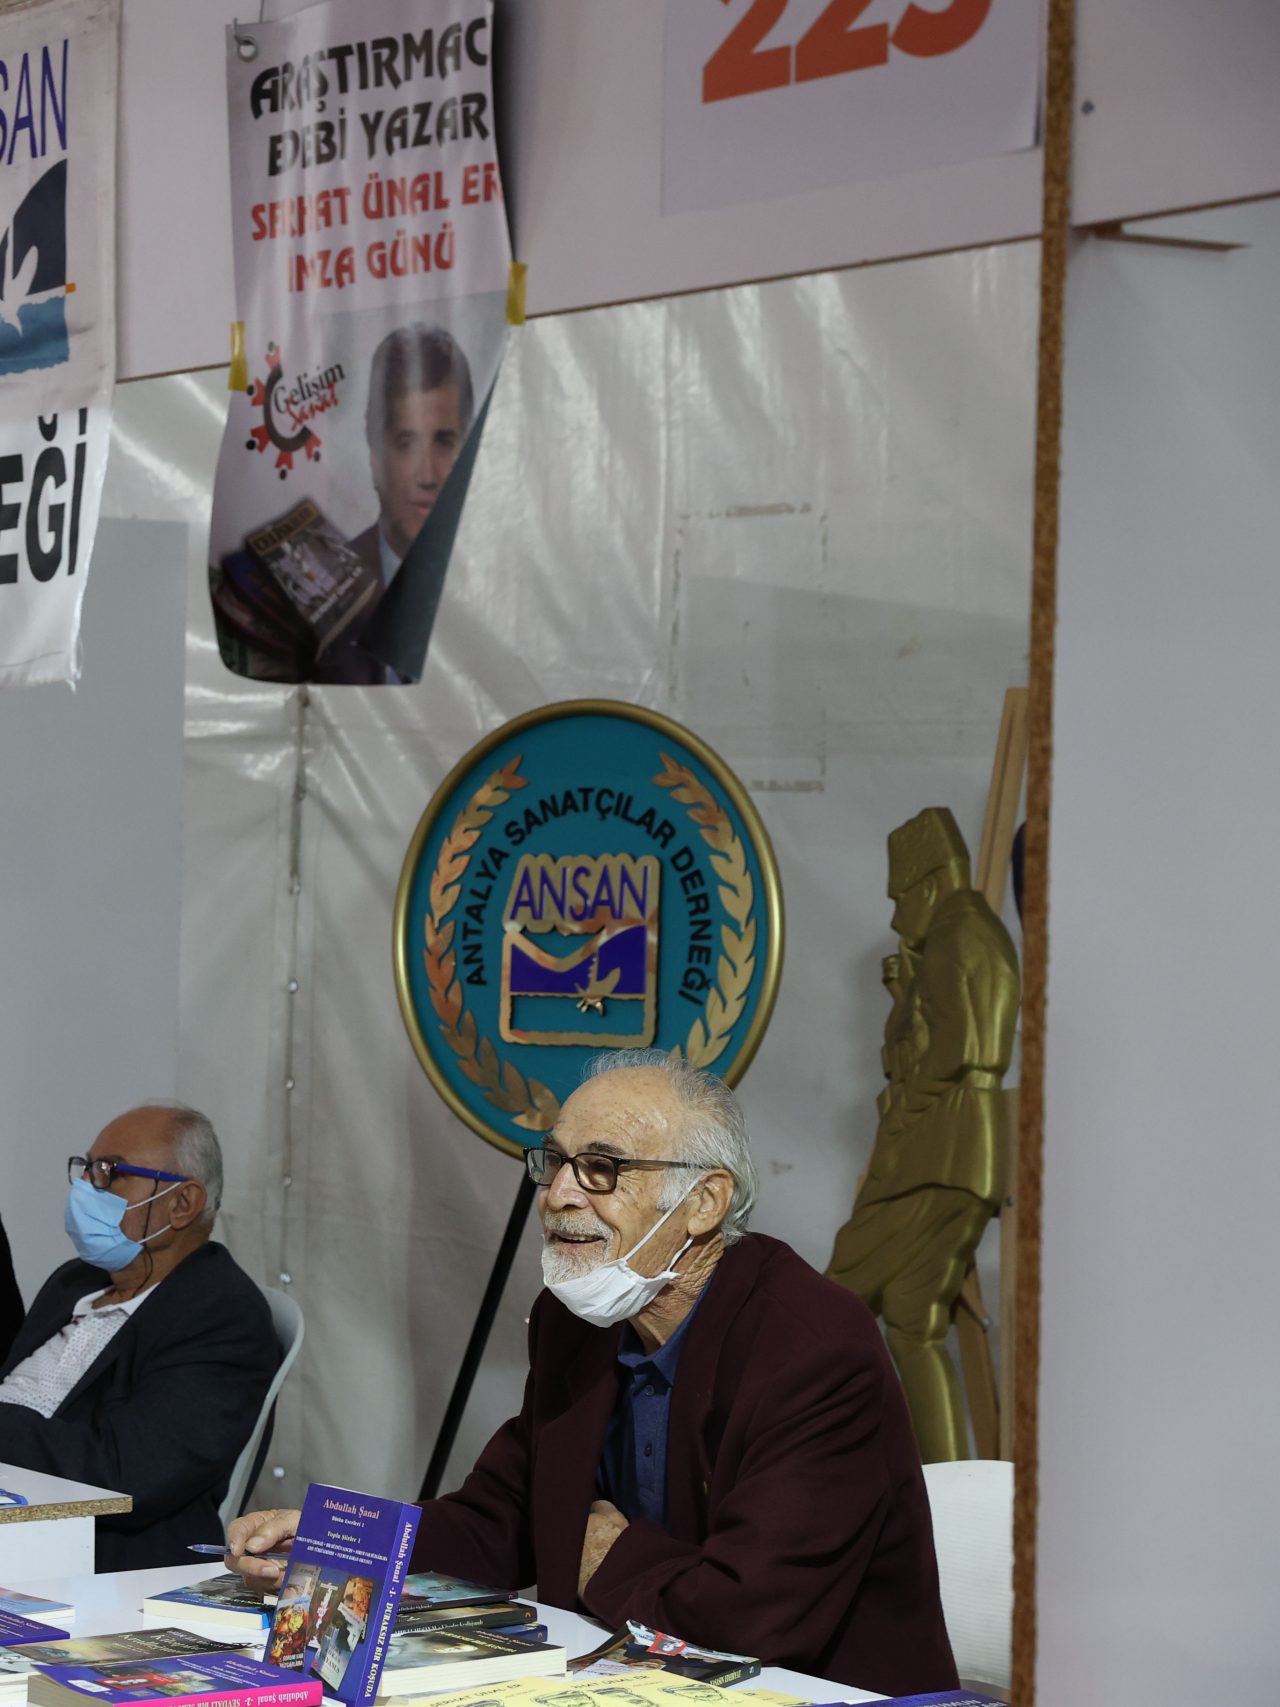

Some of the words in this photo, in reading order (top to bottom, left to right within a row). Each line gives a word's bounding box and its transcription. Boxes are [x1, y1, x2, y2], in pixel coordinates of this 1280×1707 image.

[360, 92, 489, 160] YAZAR
[363, 171, 450, 221] ÜNAL
[366, 220, 456, 280] GÜNÜ
[462, 847, 510, 987] ANTALYA
[504, 787, 677, 849] SANATÇILAR
[510, 865, 649, 922] ANSAN
[323, 1499, 357, 1515] Abdullah
[358, 1506, 380, 1520] Şanal
[398, 1521, 413, 1559] Abdullah
[392, 1560, 404, 1583] Şanal
[378, 1602, 394, 1646] DURAKSIZ
[373, 1646, 383, 1661] BİR
[257, 1691, 277, 1704] Şanal
[278, 1690, 309, 1703] Abdullah
[364, 1662, 379, 1698] KOŞUDA
